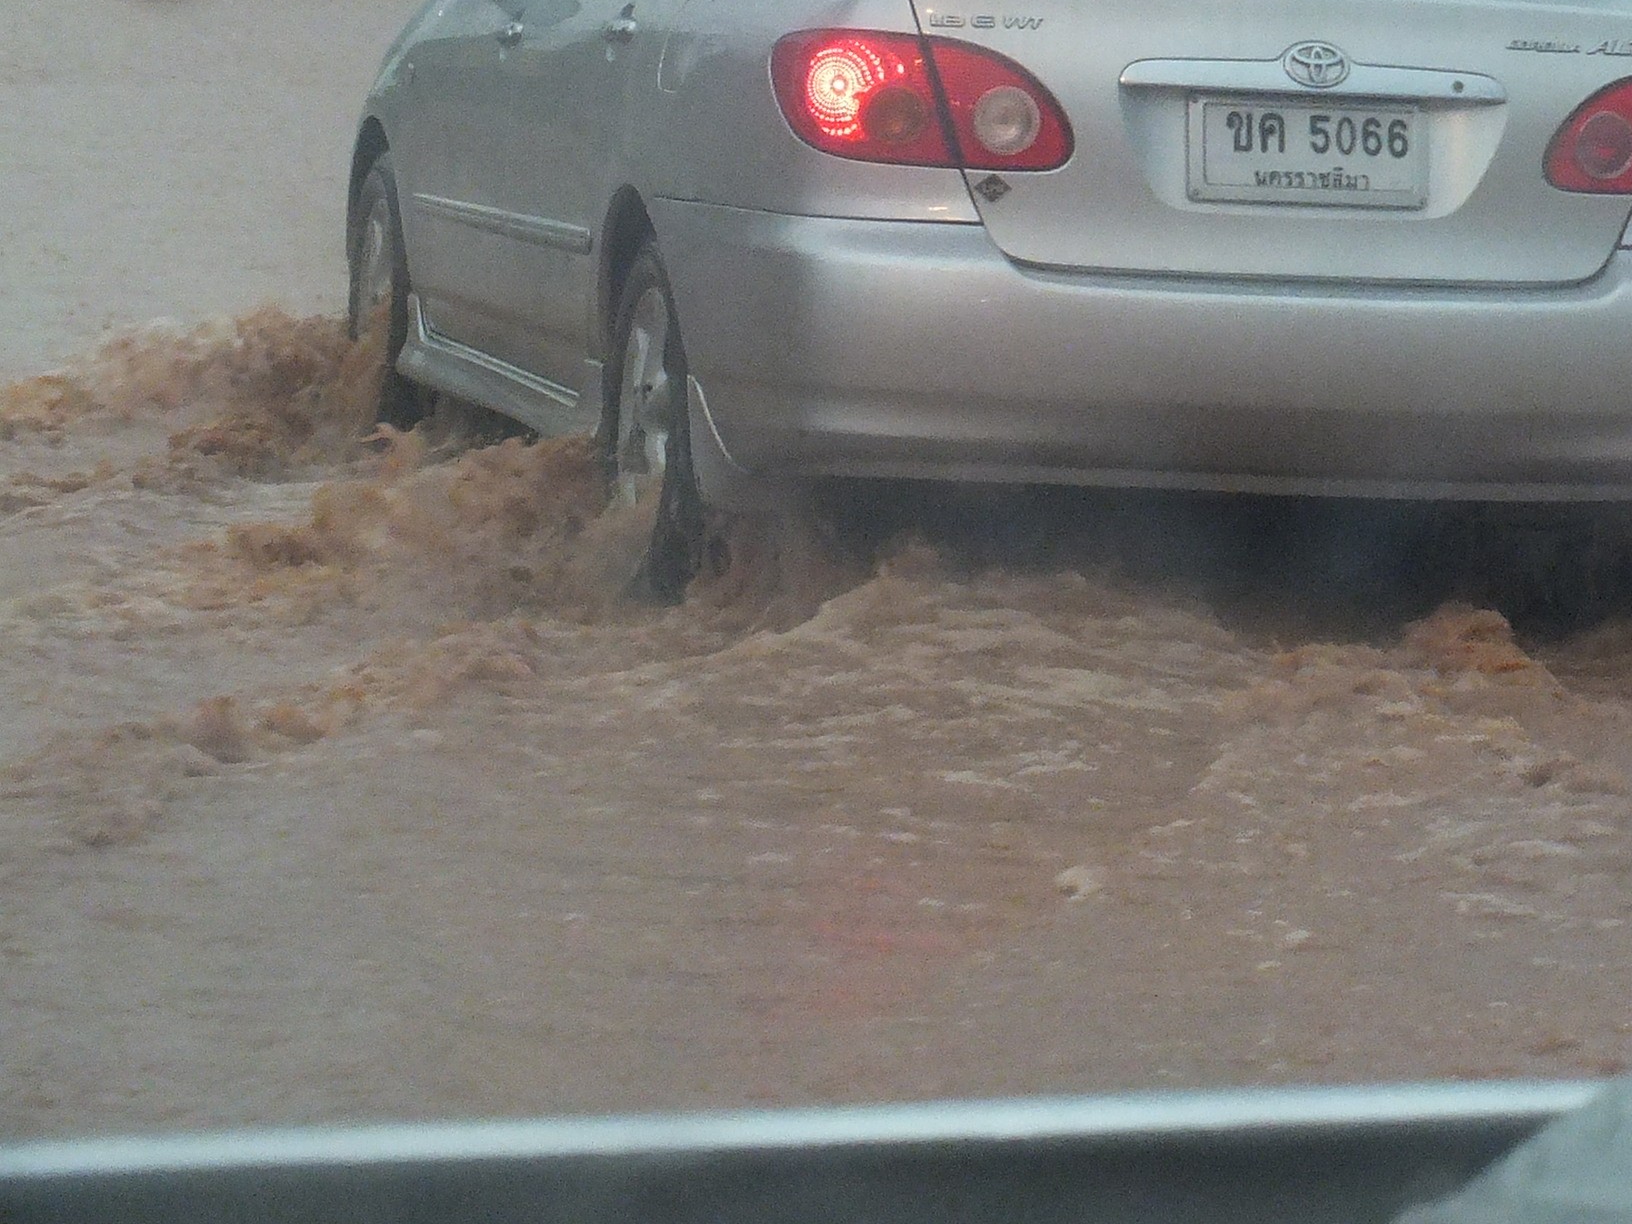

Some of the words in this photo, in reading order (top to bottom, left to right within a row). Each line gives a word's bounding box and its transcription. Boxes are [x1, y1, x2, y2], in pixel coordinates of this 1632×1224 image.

[1226, 110, 1286, 154] ขค
[1309, 114, 1409, 158] 5066
[1254, 166, 1371, 190] นครราชสีมา
